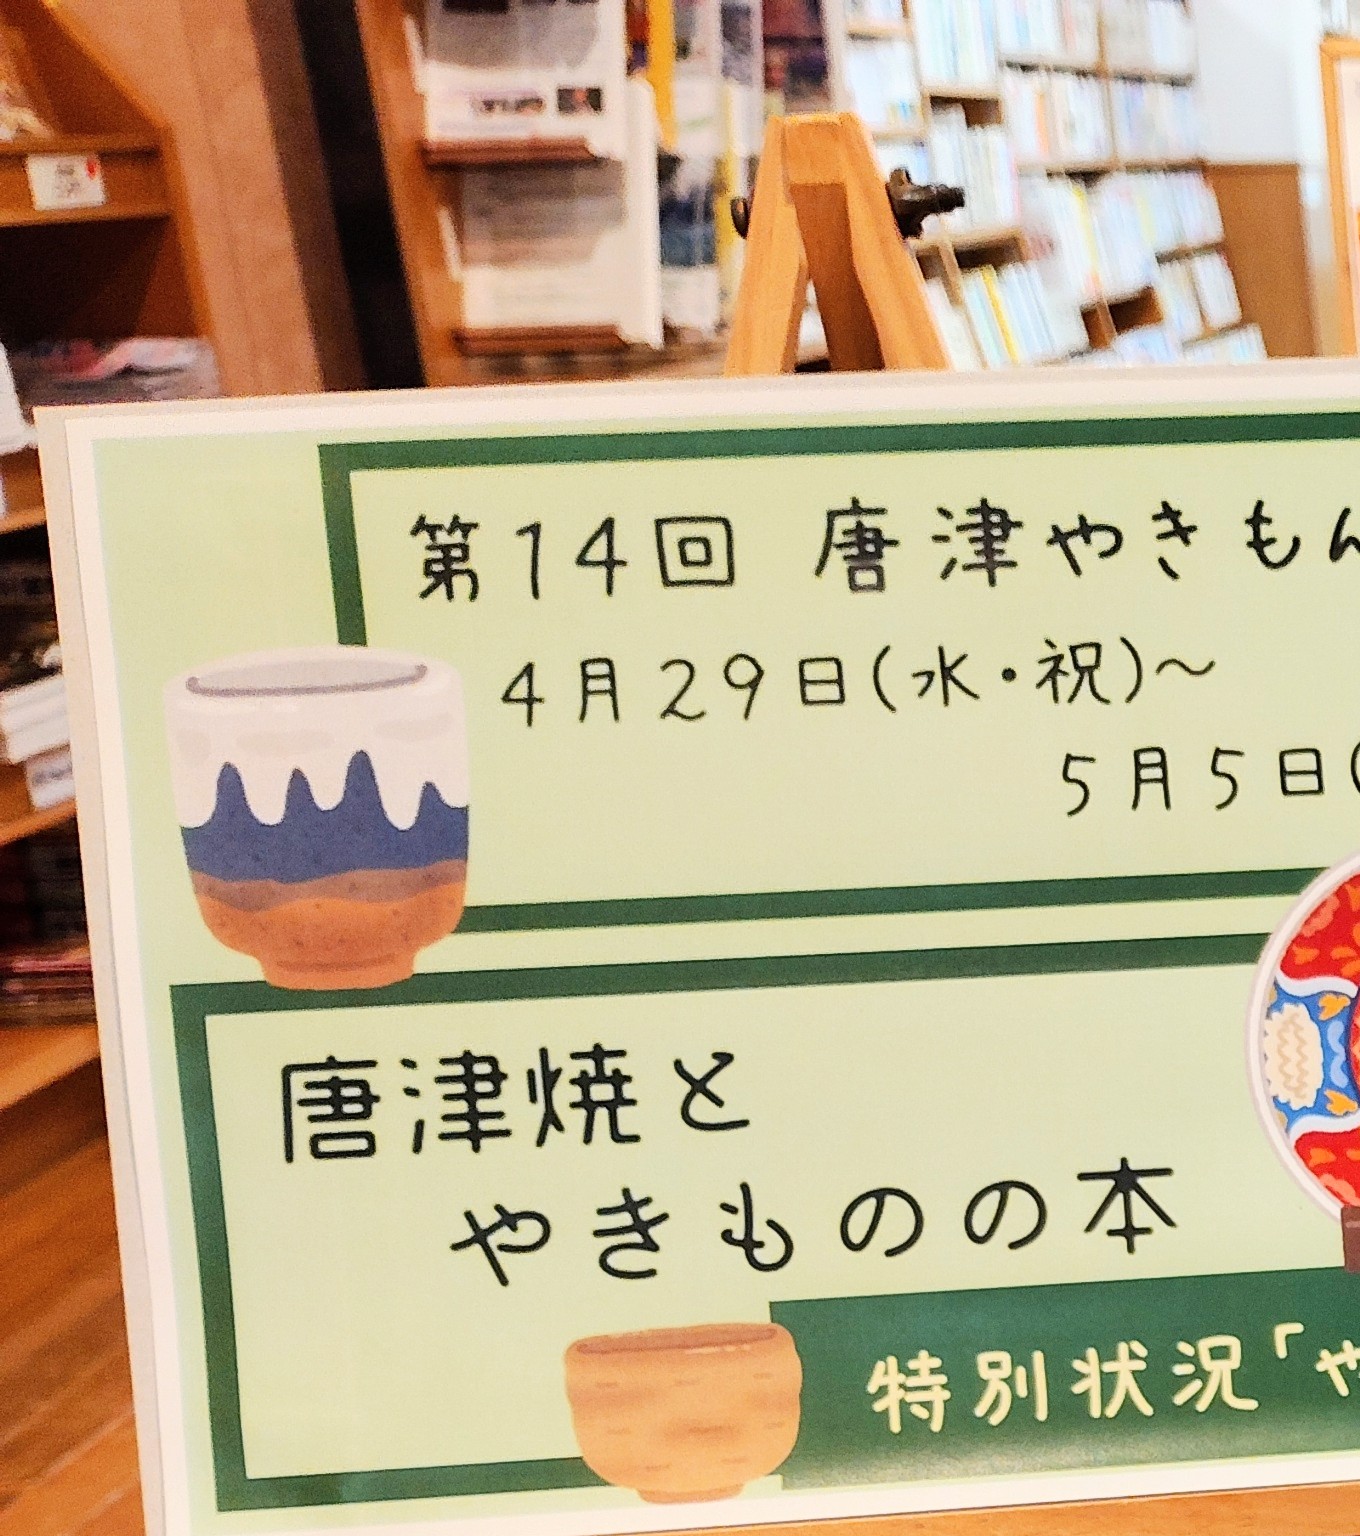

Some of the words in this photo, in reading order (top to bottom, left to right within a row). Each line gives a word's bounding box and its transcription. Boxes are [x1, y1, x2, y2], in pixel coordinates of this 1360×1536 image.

[410, 513, 736, 601] 第14回
[281, 1044, 749, 1163] 唐津焼と
[450, 1157, 1177, 1286] やきものの本
